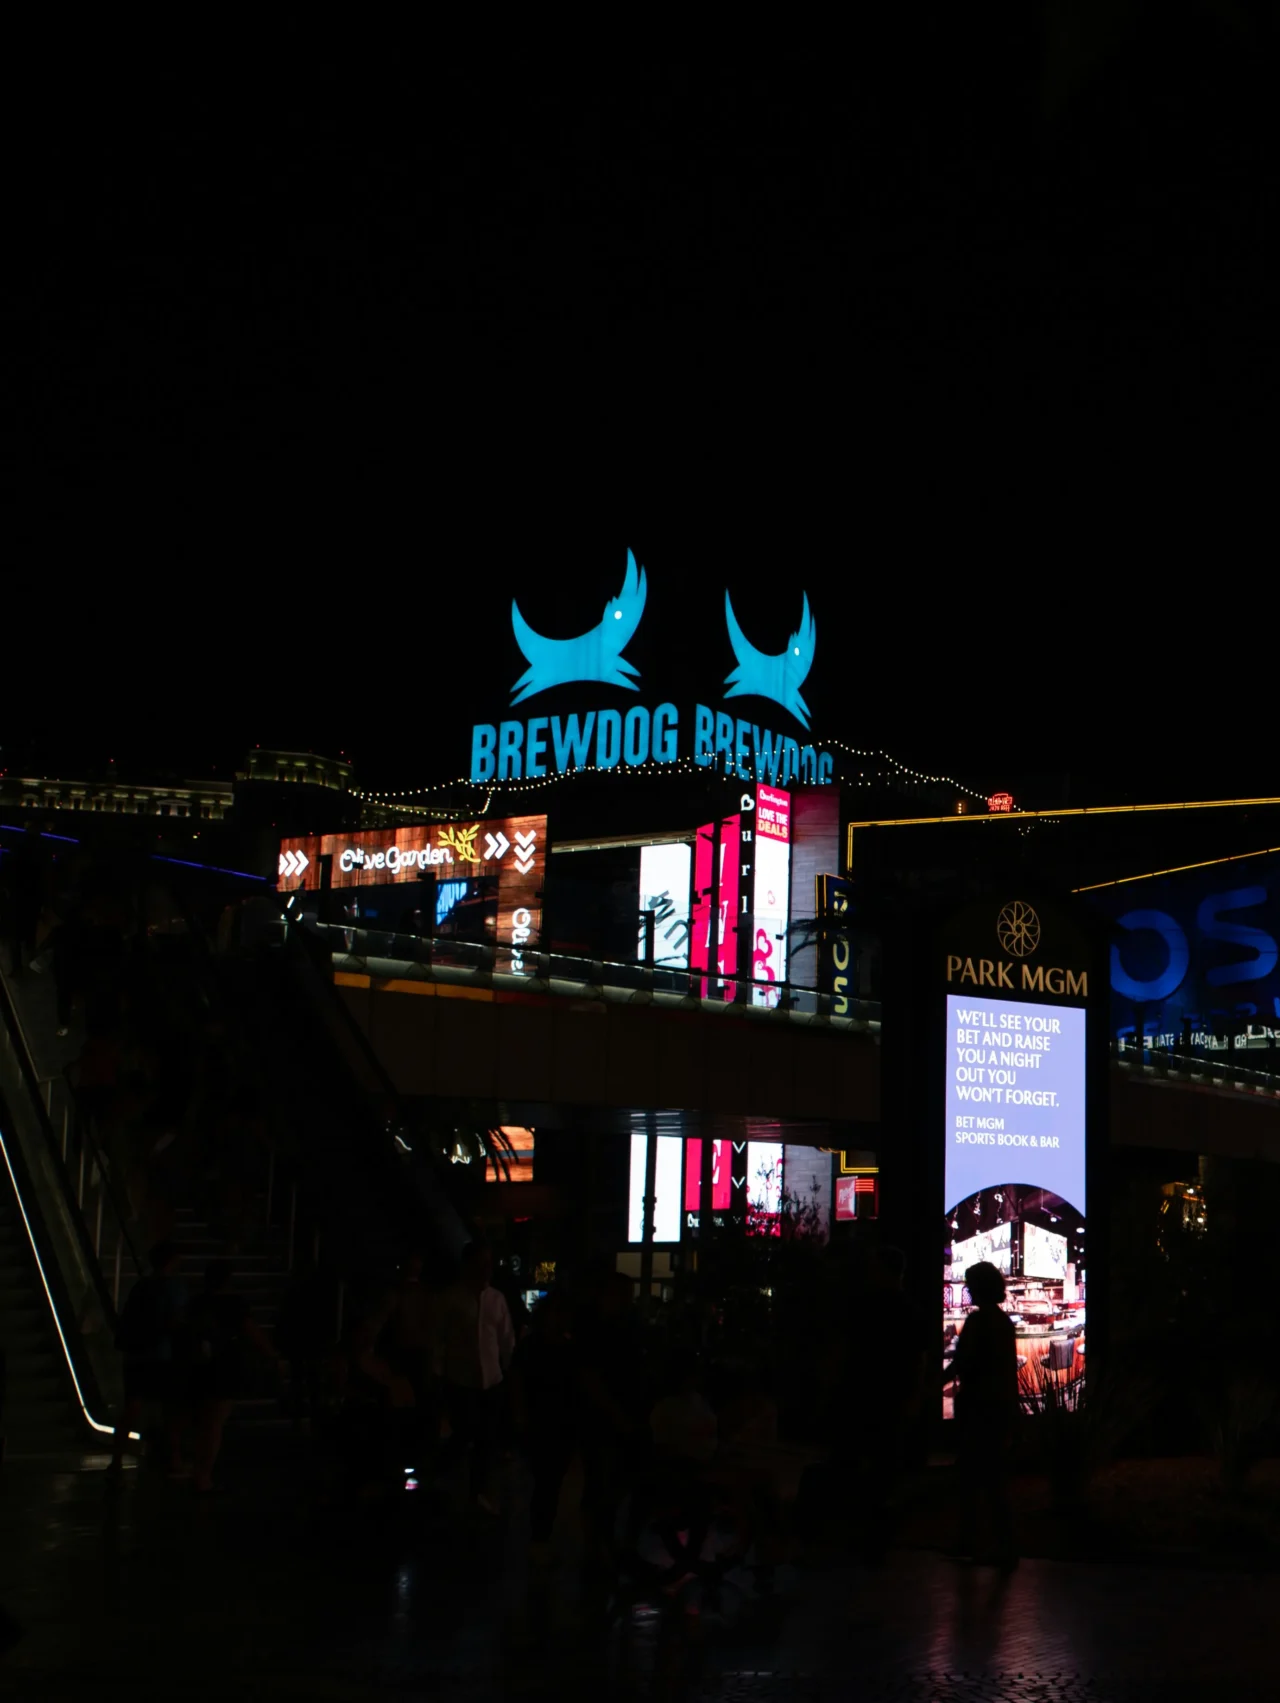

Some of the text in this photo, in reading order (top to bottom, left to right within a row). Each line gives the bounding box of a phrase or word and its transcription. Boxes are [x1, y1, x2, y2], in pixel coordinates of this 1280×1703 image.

[470, 702, 679, 784] BREWDOG
[695, 703, 834, 787] BREWDOG
[758, 806, 788, 826] LOVE THE
[757, 820, 788, 838] DEALS
[340, 843, 454, 874] Olive Garden
[947, 955, 1088, 997] PARK MGM
[956, 1009, 1061, 1034] WE'LL SEE YOUR
[956, 1028, 1051, 1051] BET AND RAISE
[956, 1047, 1042, 1069] YOU A NIGHT
[956, 1066, 1017, 1085] OUT YOU
[955, 1085, 1060, 1107] WON'T FORGET.
[955, 1115, 1005, 1130] BET MGM
[955, 1131, 1060, 1148] SPORTS BOOK & BAR
